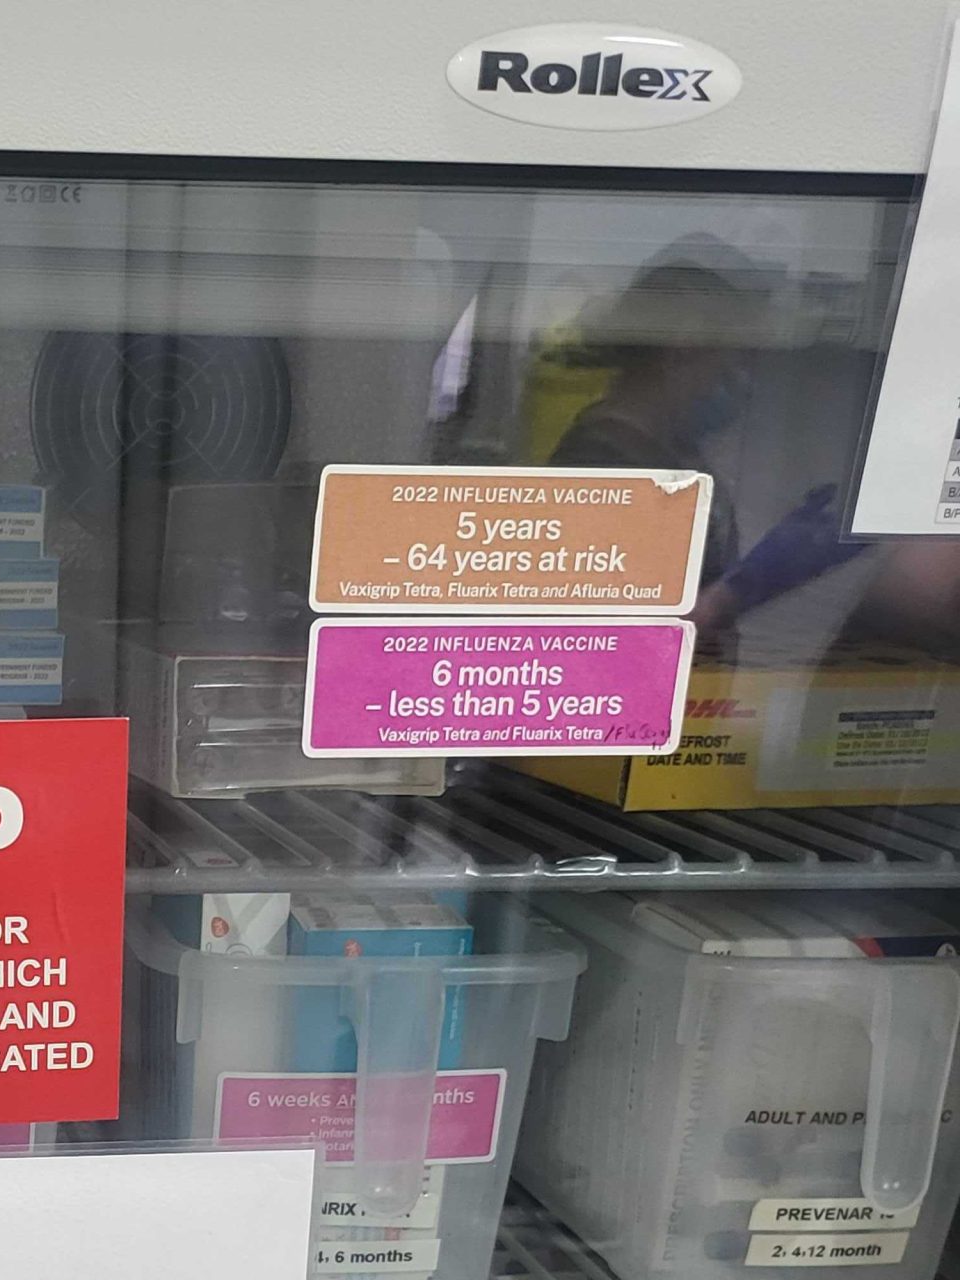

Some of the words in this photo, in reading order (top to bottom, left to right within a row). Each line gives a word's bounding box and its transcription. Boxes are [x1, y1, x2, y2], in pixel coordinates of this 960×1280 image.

[392, 486, 438, 502] 2022
[443, 487, 546, 504] INFLUENZA
[552, 488, 632, 505] VACCINE
[456, 511, 477, 540] 5
[482, 516, 561, 544] years
[407, 544, 447, 571] 64
[452, 549, 531, 577] years
[538, 549, 567, 572] at
[574, 545, 626, 572] risk
[339, 581, 400, 600] Vaxigrip
[448, 582, 499, 599] Fluarix
[502, 583, 539, 598] Tetra
[541, 584, 568, 598] and
[570, 583, 619, 600] Afluria
[622, 584, 661, 600] Quad
[383, 637, 428, 652] 2022
[433, 636, 534, 652] INFLUENZA
[540, 636, 618, 652] VACCINE
[432, 660, 452, 687] 6
[458, 659, 563, 687] months
[389, 692, 444, 718] less
[452, 691, 514, 717] than
[521, 690, 540, 716] 5
[546, 692, 623, 720] years
[379, 726, 439, 744] Vaxigrip
[443, 727, 480, 742] Tetra
[482, 727, 510, 742] and
[512, 726, 563, 742] Fluarix
[566, 726, 603, 741] Tetra
[680, 735, 731, 748] EFROST
[646, 753, 688, 767] DATE
[687, 753, 713, 766] AND
[0, 1002, 76, 1032] AND
[247, 1091, 260, 1107] 6
[268, 1091, 331, 1108] weeks
[336, 1094, 356, 1108] AN
[433, 1088, 475, 1105] nths
[320, 1115, 355, 1127] Preve
[745, 1110, 807, 1124] ADULT
[810, 1111, 848, 1125] AND
[776, 1207, 873, 1221] PREVENAR
[334, 1251, 344, 1263] 6
[350, 1249, 413, 1264] months
[830, 1244, 882, 1258] month
